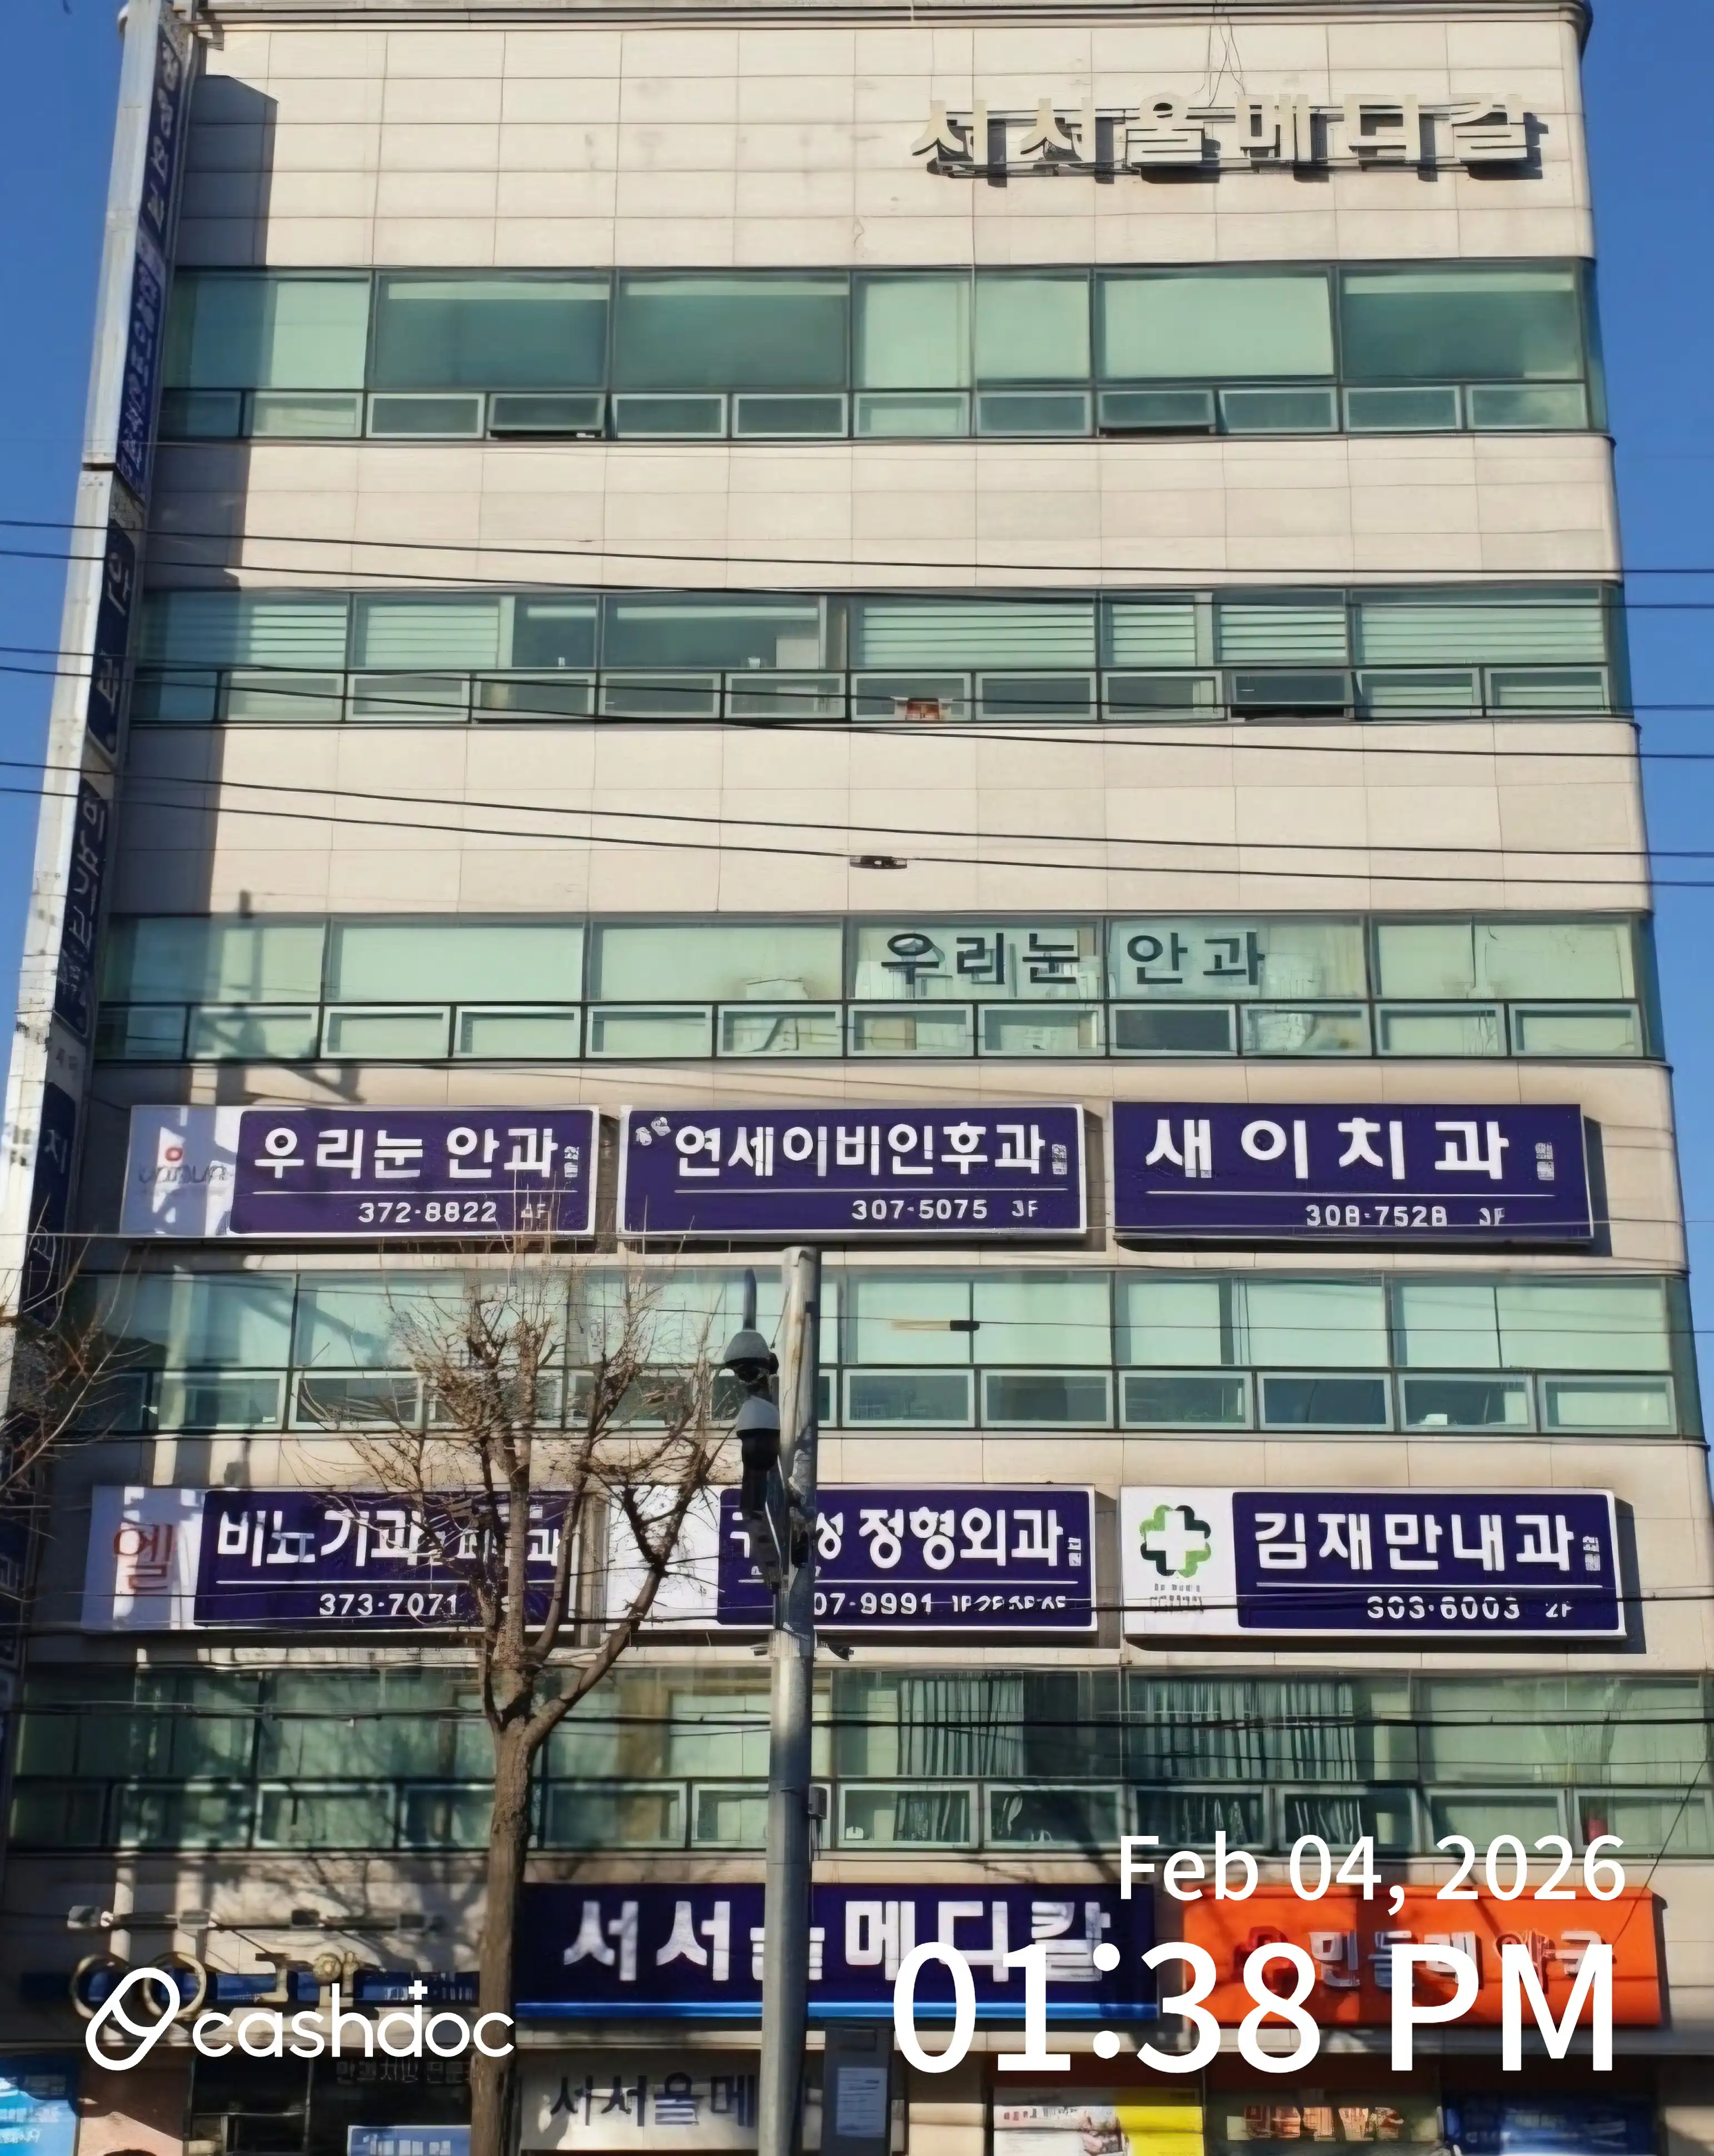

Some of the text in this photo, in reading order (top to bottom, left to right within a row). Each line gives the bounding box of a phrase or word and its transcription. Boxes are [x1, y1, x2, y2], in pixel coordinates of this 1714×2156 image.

[880, 931, 1265, 985] 우리눈 안과
[255, 1127, 423, 1179] 우리눈
[446, 1127, 559, 1179] 안과
[675, 1121, 1045, 1177] 연세이비인후과
[1145, 1117, 1509, 1180] 새이치과
[217, 1509, 428, 1567] 비뇨기과
[859, 1506, 1064, 1570] 정형외과
[1255, 1513, 1575, 1571] 김재만내과
